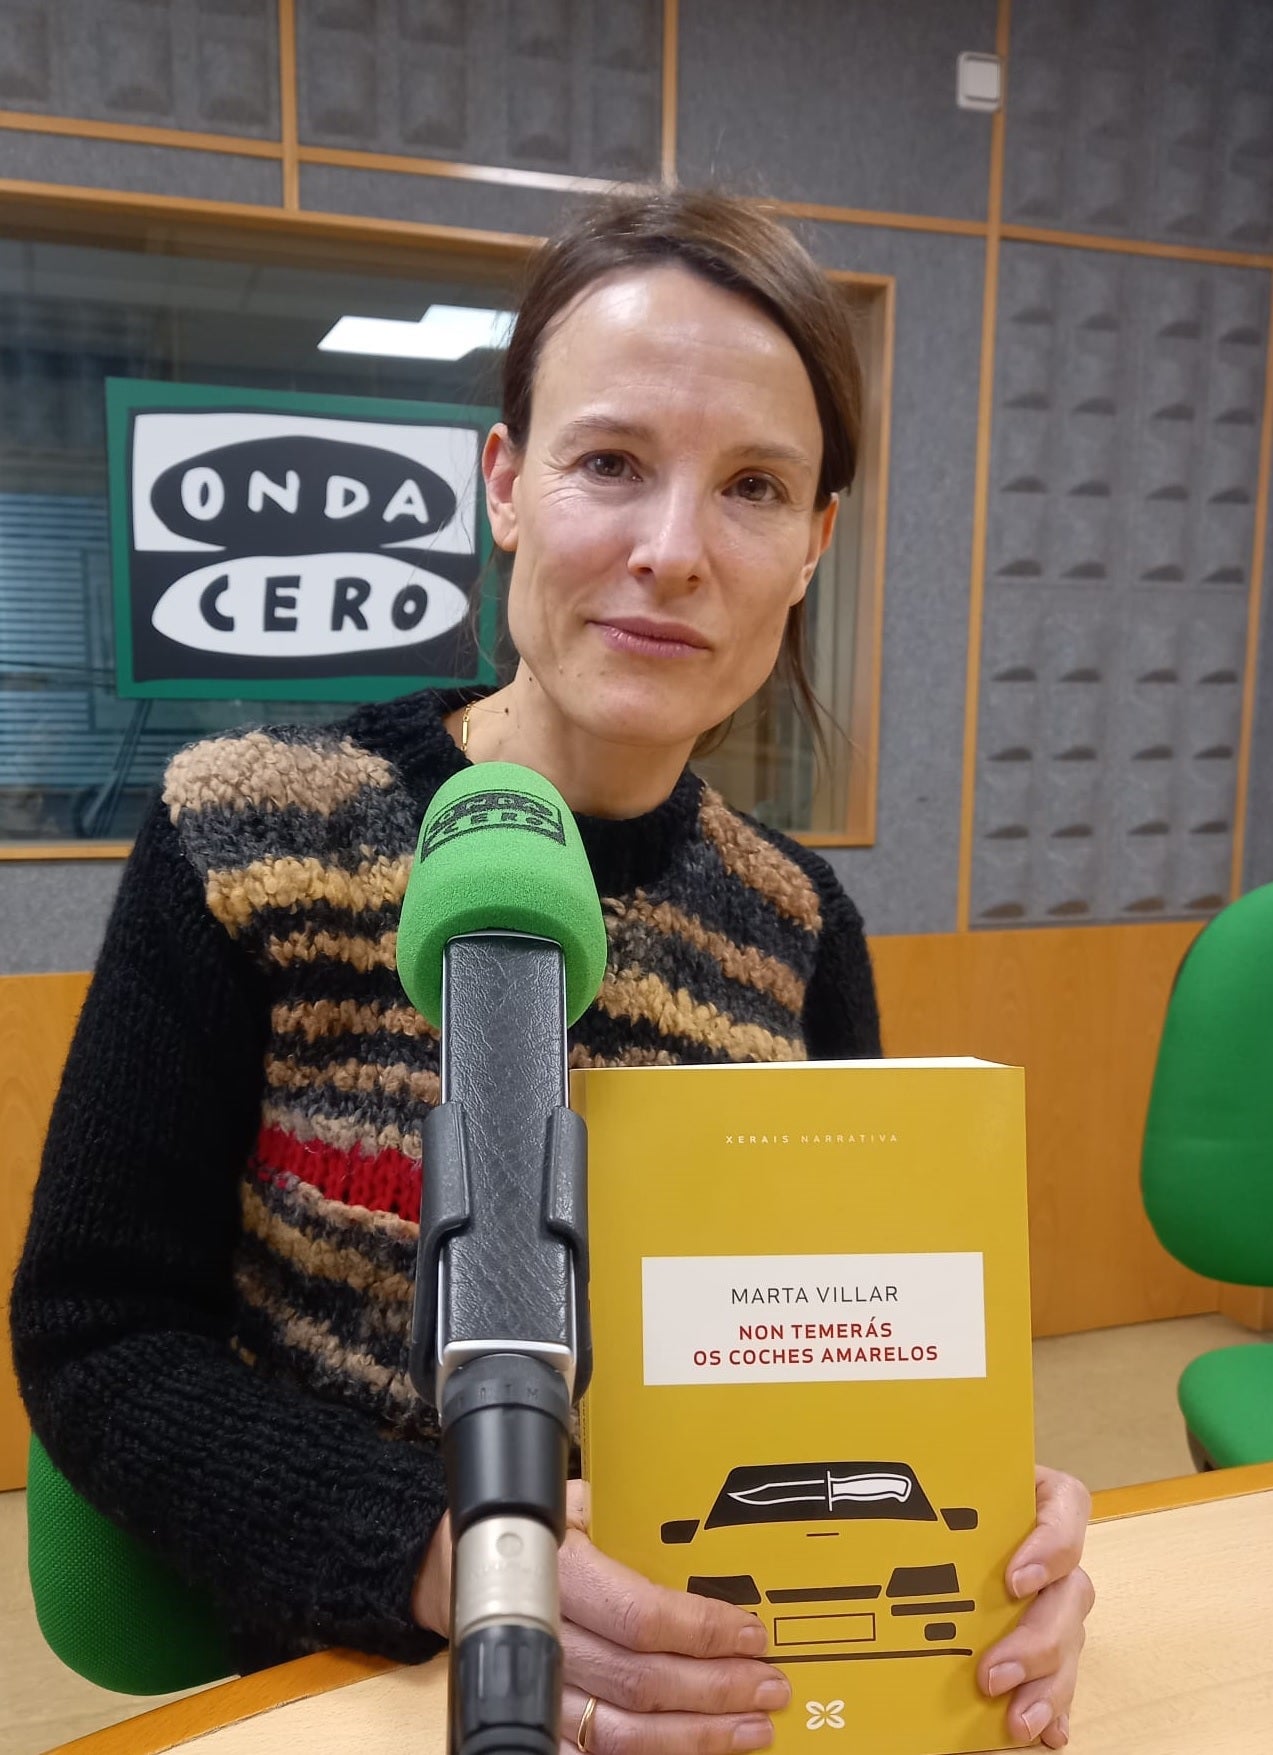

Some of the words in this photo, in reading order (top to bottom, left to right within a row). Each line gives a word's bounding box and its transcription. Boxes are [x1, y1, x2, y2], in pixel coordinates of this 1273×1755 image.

[180, 466, 429, 524] ONDA
[199, 574, 429, 632] CERO
[725, 1134, 790, 1144] XERAIS
[800, 1133, 898, 1144] NARRATIVA
[731, 1286, 809, 1305] MARTA
[816, 1285, 898, 1303] VILLAR
[739, 1324, 784, 1340] NON
[790, 1316, 893, 1340] TEMERÁS
[693, 1350, 722, 1366] OS
[728, 1348, 814, 1365] COCHES
[820, 1345, 938, 1363] AMARELOS
